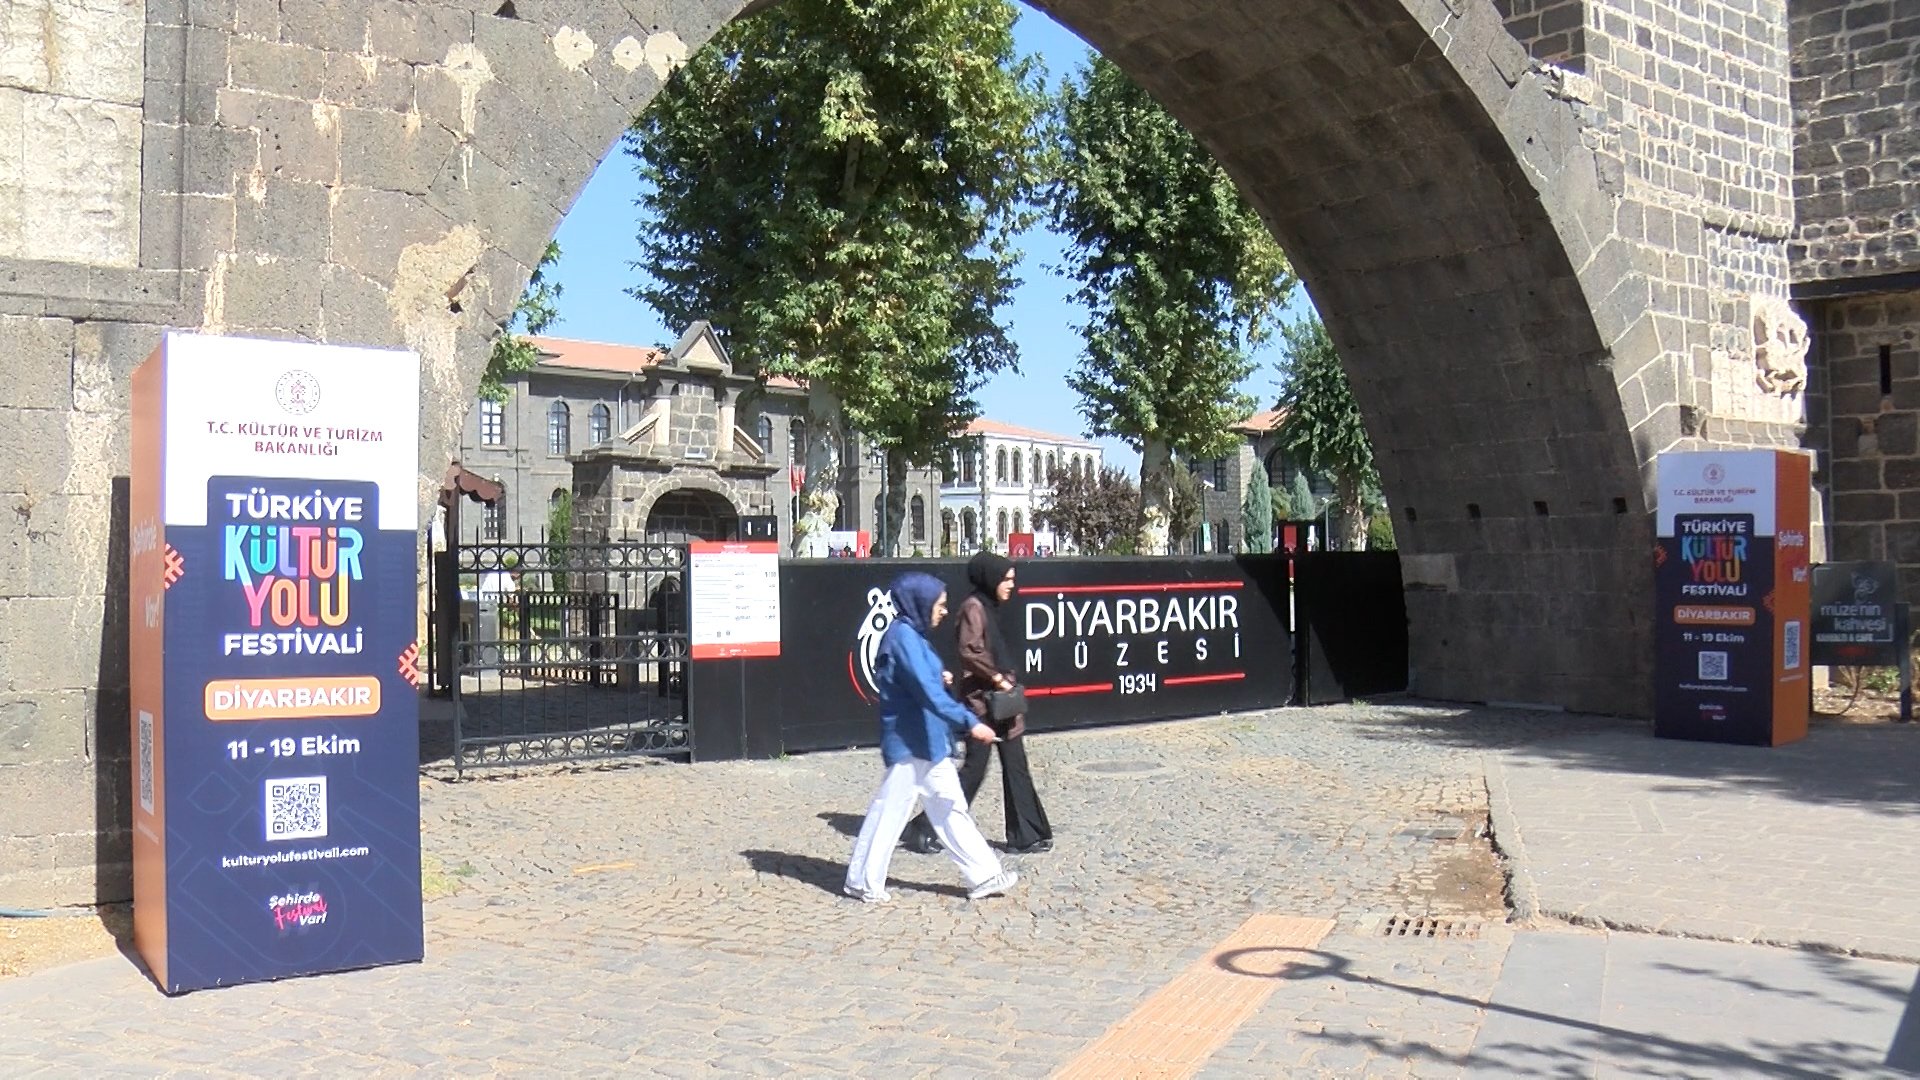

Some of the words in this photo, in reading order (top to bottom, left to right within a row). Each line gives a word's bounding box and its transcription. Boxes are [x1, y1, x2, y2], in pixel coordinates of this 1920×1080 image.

[207, 421, 233, 434] T.C.
[238, 421, 298, 437] KÜLTÜR
[303, 427, 321, 439] VE
[326, 428, 383, 442] TURİZM
[254, 441, 338, 456] BAKANLIĞI
[225, 487, 363, 521] TÜRKİYE
[1682, 519, 1746, 534] TÜRKİYE
[224, 524, 364, 581] KÜLTÜR
[1681, 535, 1747, 562] KÜLTÜR
[1691, 559, 1741, 582] YOLU
[243, 574, 349, 627] YOLU
[1682, 583, 1748, 596] FESTİVALİ
[1025, 593, 1239, 640] DİYARBAKIR
[1677, 607, 1751, 620] DİYARBAKIR
[224, 627, 363, 656] FESTİVALİ
[1682, 632, 1692, 642] 11
[1702, 633, 1714, 642] 19
[1715, 633, 1745, 643] Ekim
[1119, 674, 1156, 695] 1934
[213, 685, 371, 711] DİYARBAKIR
[227, 740, 248, 760] 11
[270, 737, 296, 758] 19
[301, 734, 361, 756] Ekim
[222, 846, 369, 868] kulturyolufestivali.com
[269, 892, 321, 910] Şehirde
